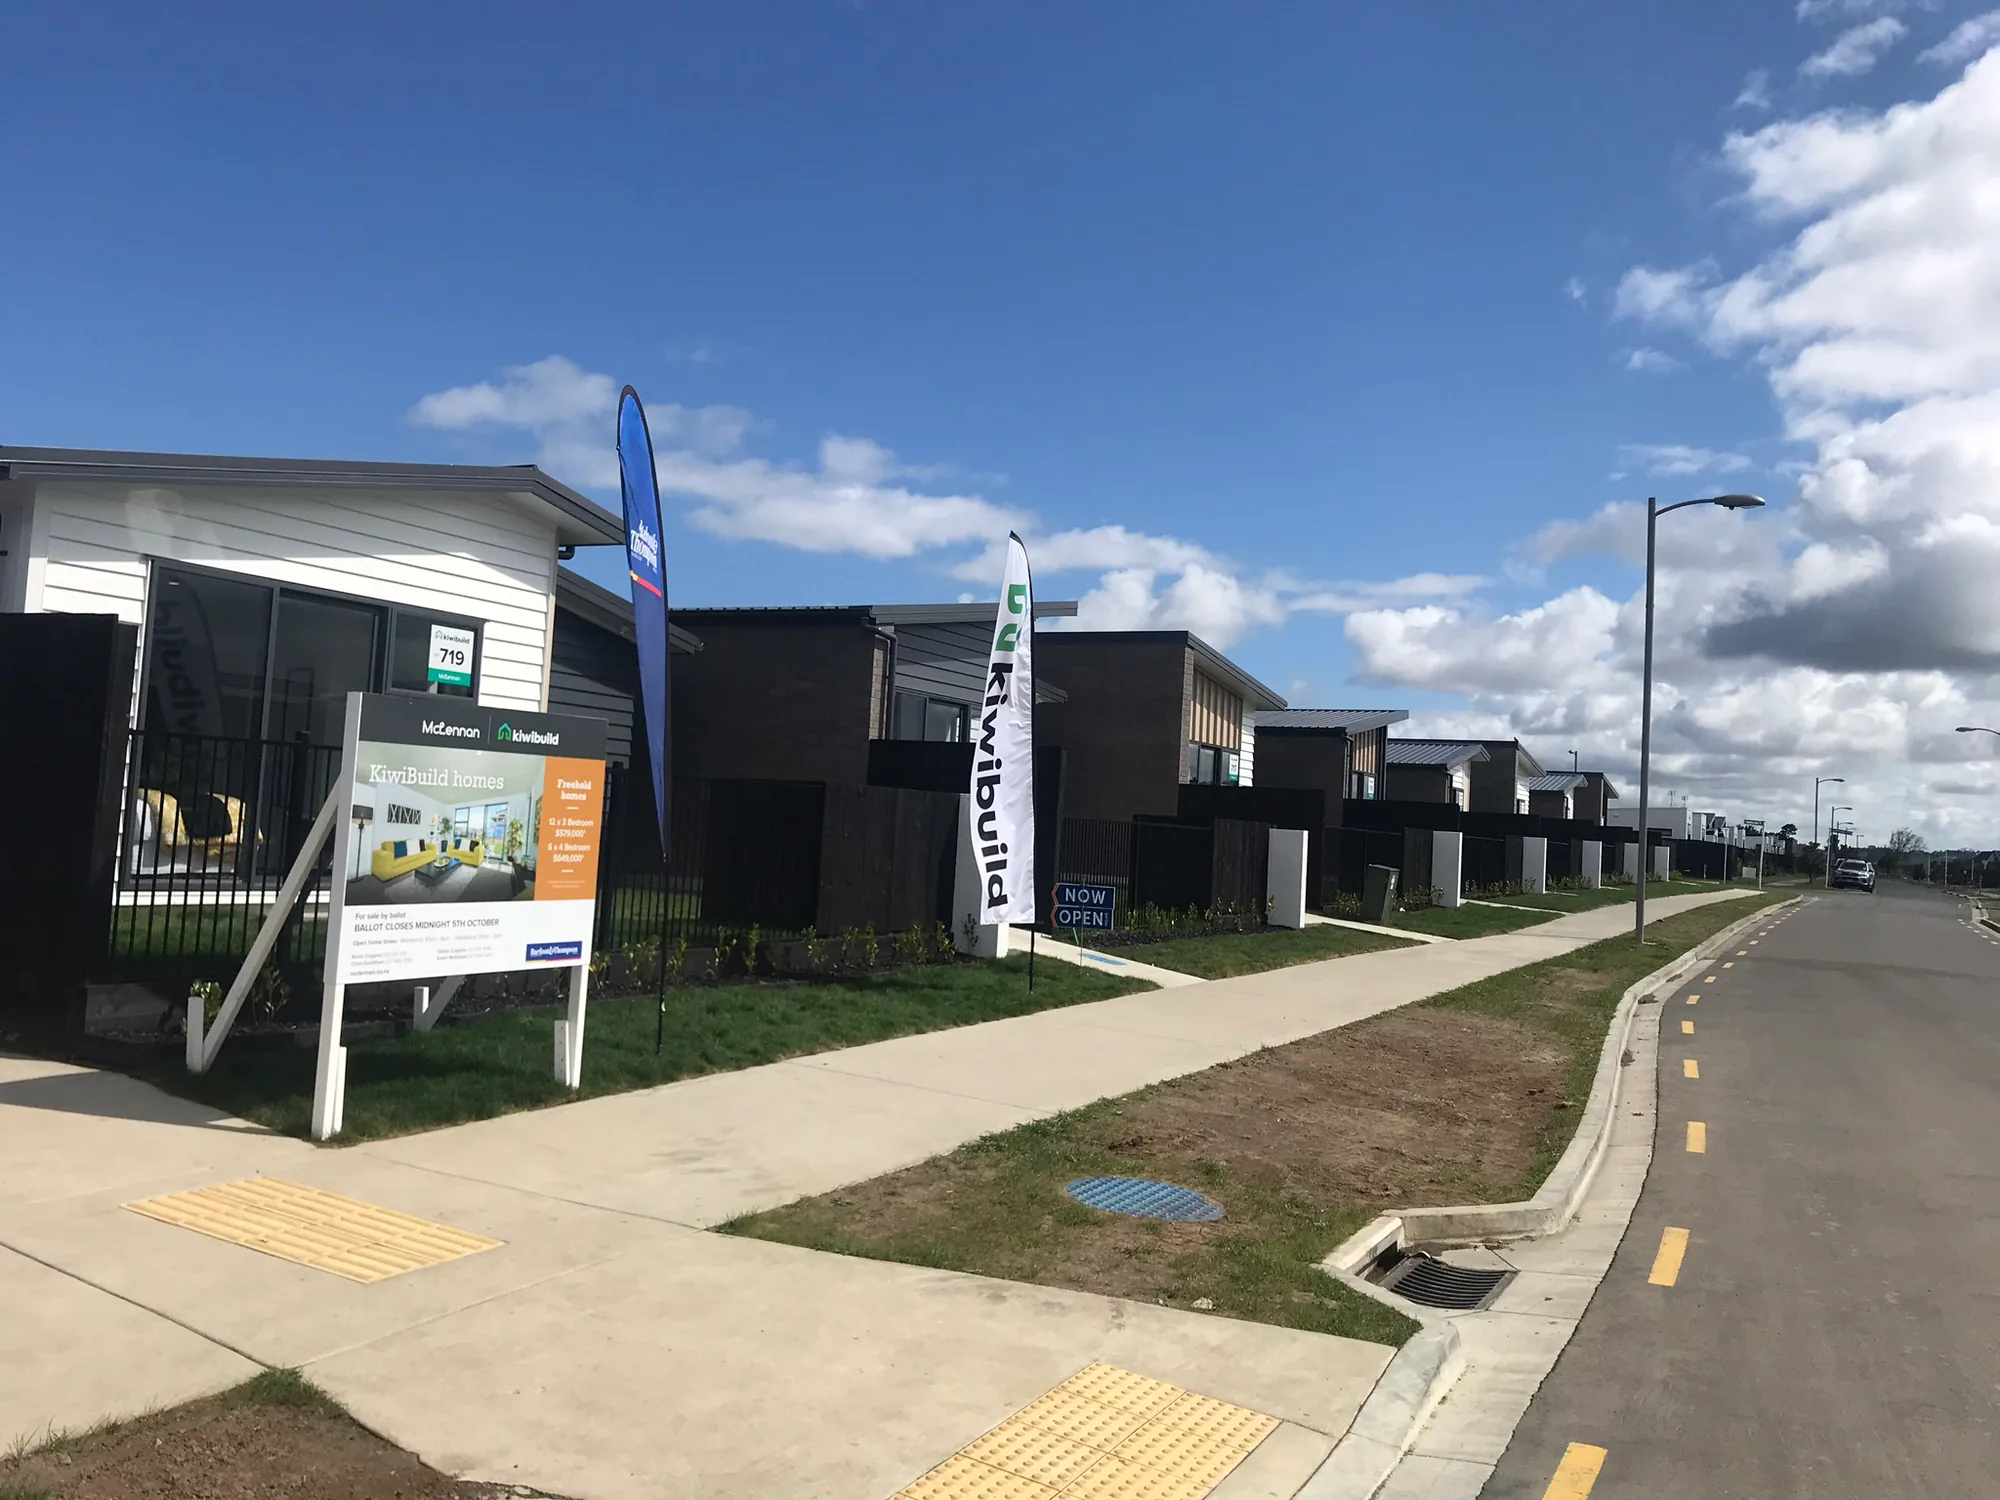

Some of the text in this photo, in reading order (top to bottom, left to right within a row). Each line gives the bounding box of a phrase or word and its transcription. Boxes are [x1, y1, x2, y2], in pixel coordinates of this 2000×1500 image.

[443, 633, 470, 645] kiwibuild
[440, 647, 465, 666] 719
[422, 719, 480, 739] McLennan
[512, 729, 559, 746] kiwibuild
[369, 764, 505, 790] KiwiBuild homes
[557, 779, 592, 790] Freehold
[976, 662, 1015, 909] kiwibuild
[560, 790, 587, 801] homes
[567, 818, 594, 828] Bedroom
[564, 843, 592, 852] Bedroom
[1065, 887, 1106, 905] NOW
[355, 911, 406, 921] For sale by ballot
[1059, 909, 1103, 927] OPEN
[354, 918, 500, 932] BALLOT CLOSES MIDNIGHT 5TH OCTOBER
